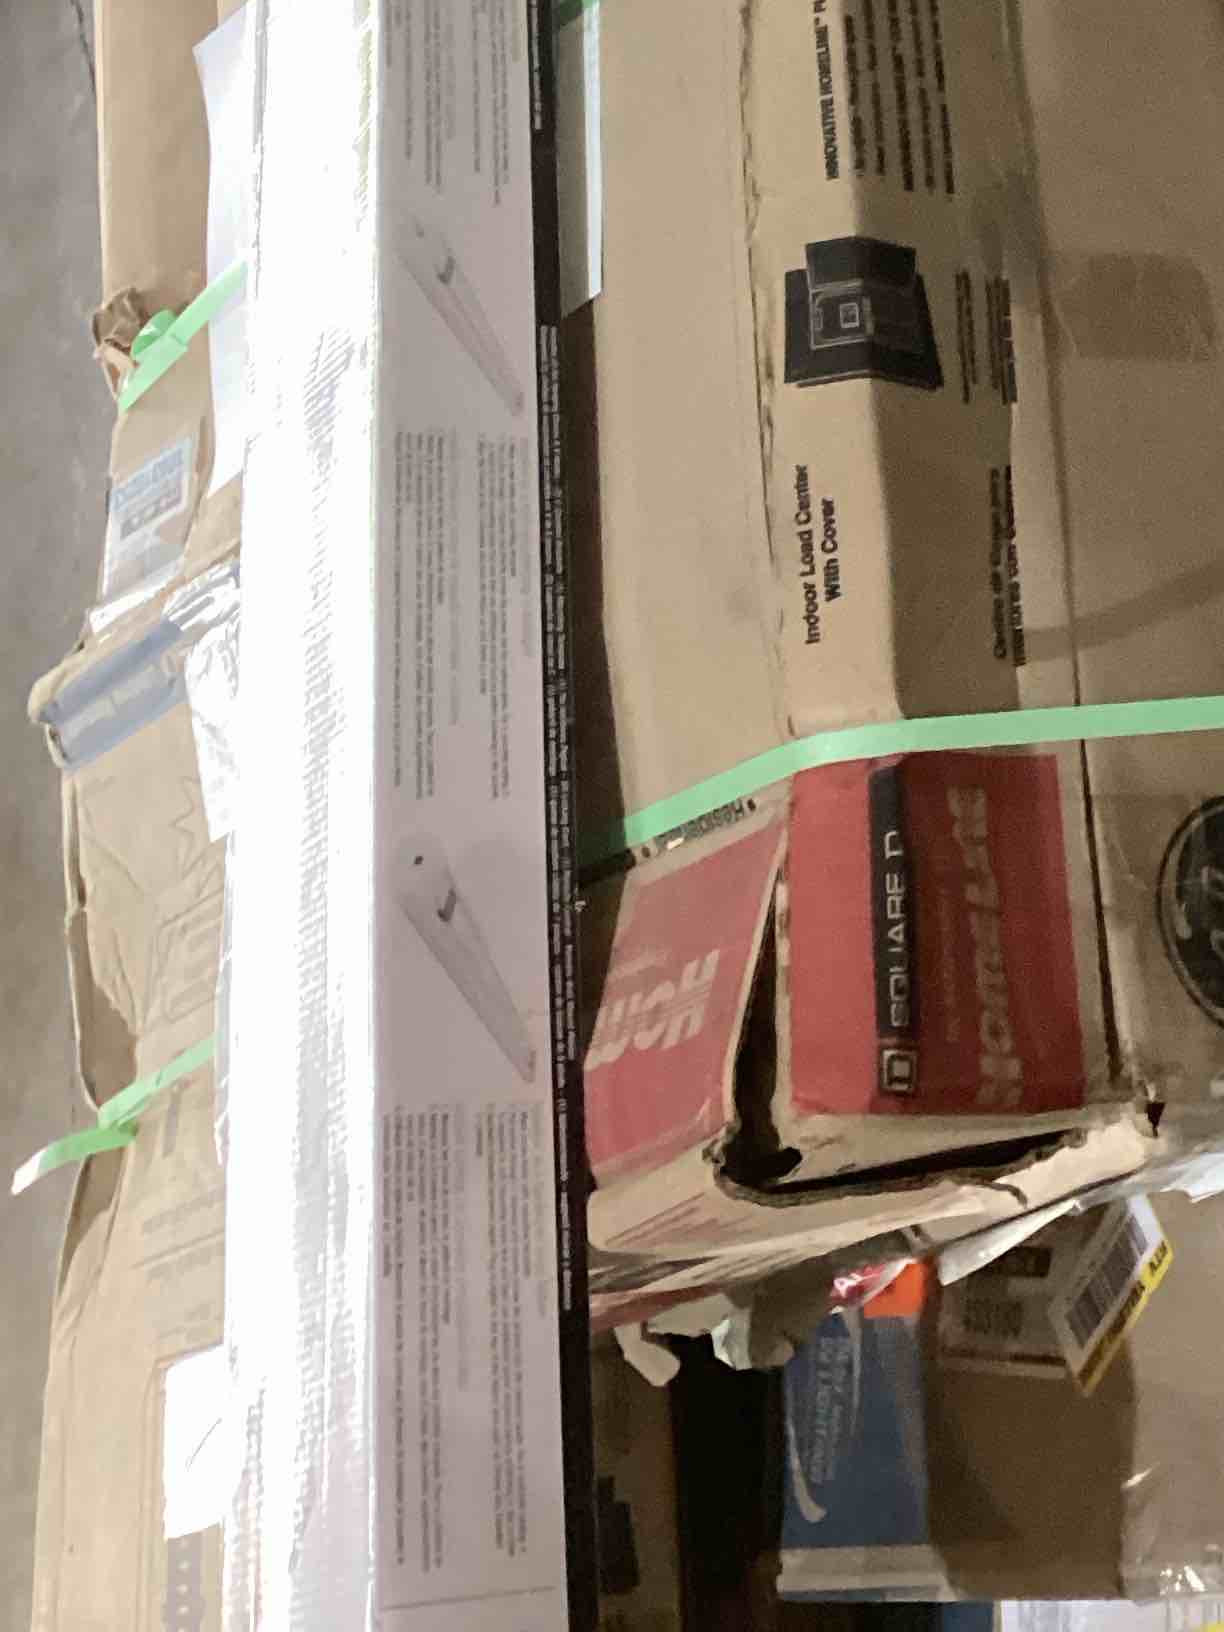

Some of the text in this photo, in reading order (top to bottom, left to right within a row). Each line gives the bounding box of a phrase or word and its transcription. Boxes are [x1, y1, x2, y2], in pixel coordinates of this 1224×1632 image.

[819, 97, 840, 179] INNOVATIVE
[792, 464, 821, 644] Indoor Load Center
[818, 498, 841, 601] With Cover
[886, 872, 909, 1026] SQUARE
